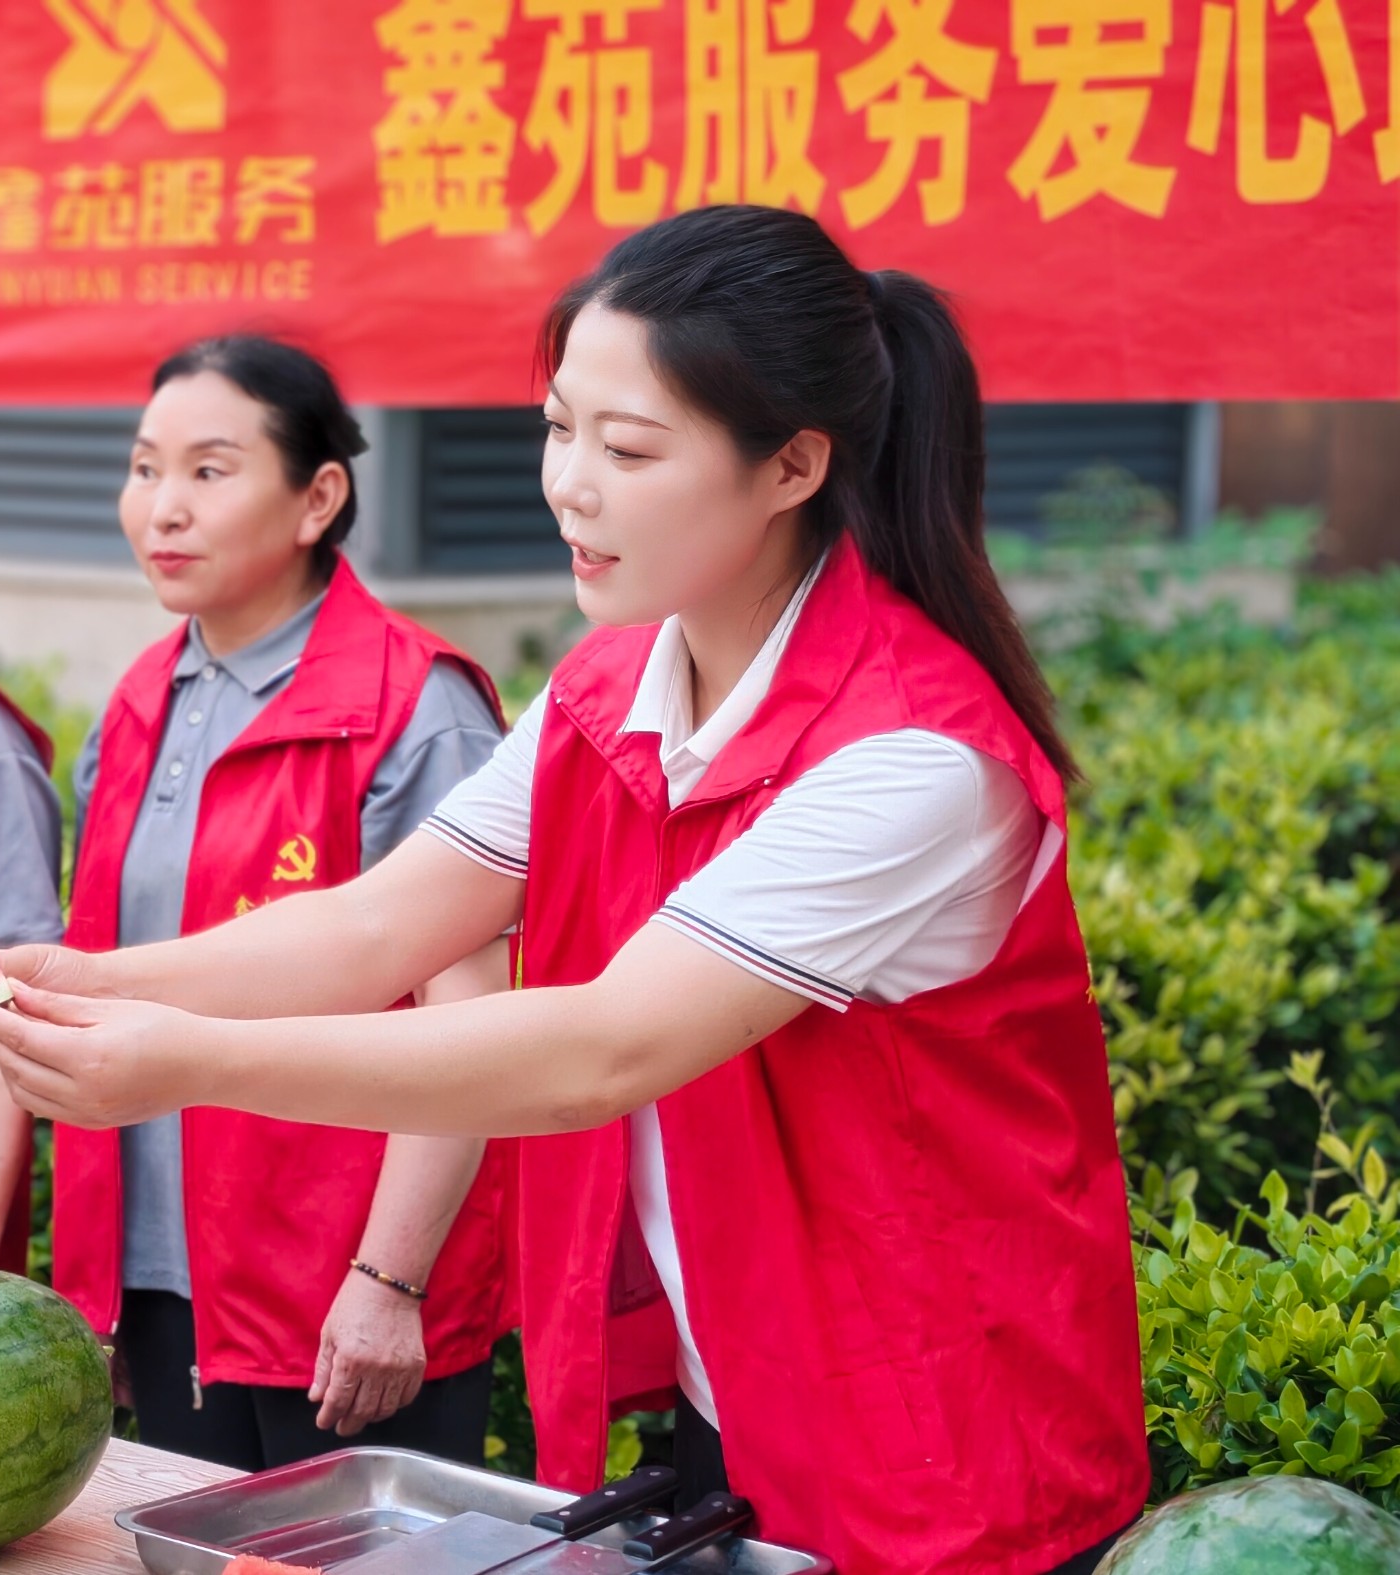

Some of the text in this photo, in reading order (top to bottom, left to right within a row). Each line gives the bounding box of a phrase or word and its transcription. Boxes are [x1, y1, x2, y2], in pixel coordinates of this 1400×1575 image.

[373, 0, 1400, 246] 鑫苑服务爱心
[134, 258, 314, 304] SERVICE
